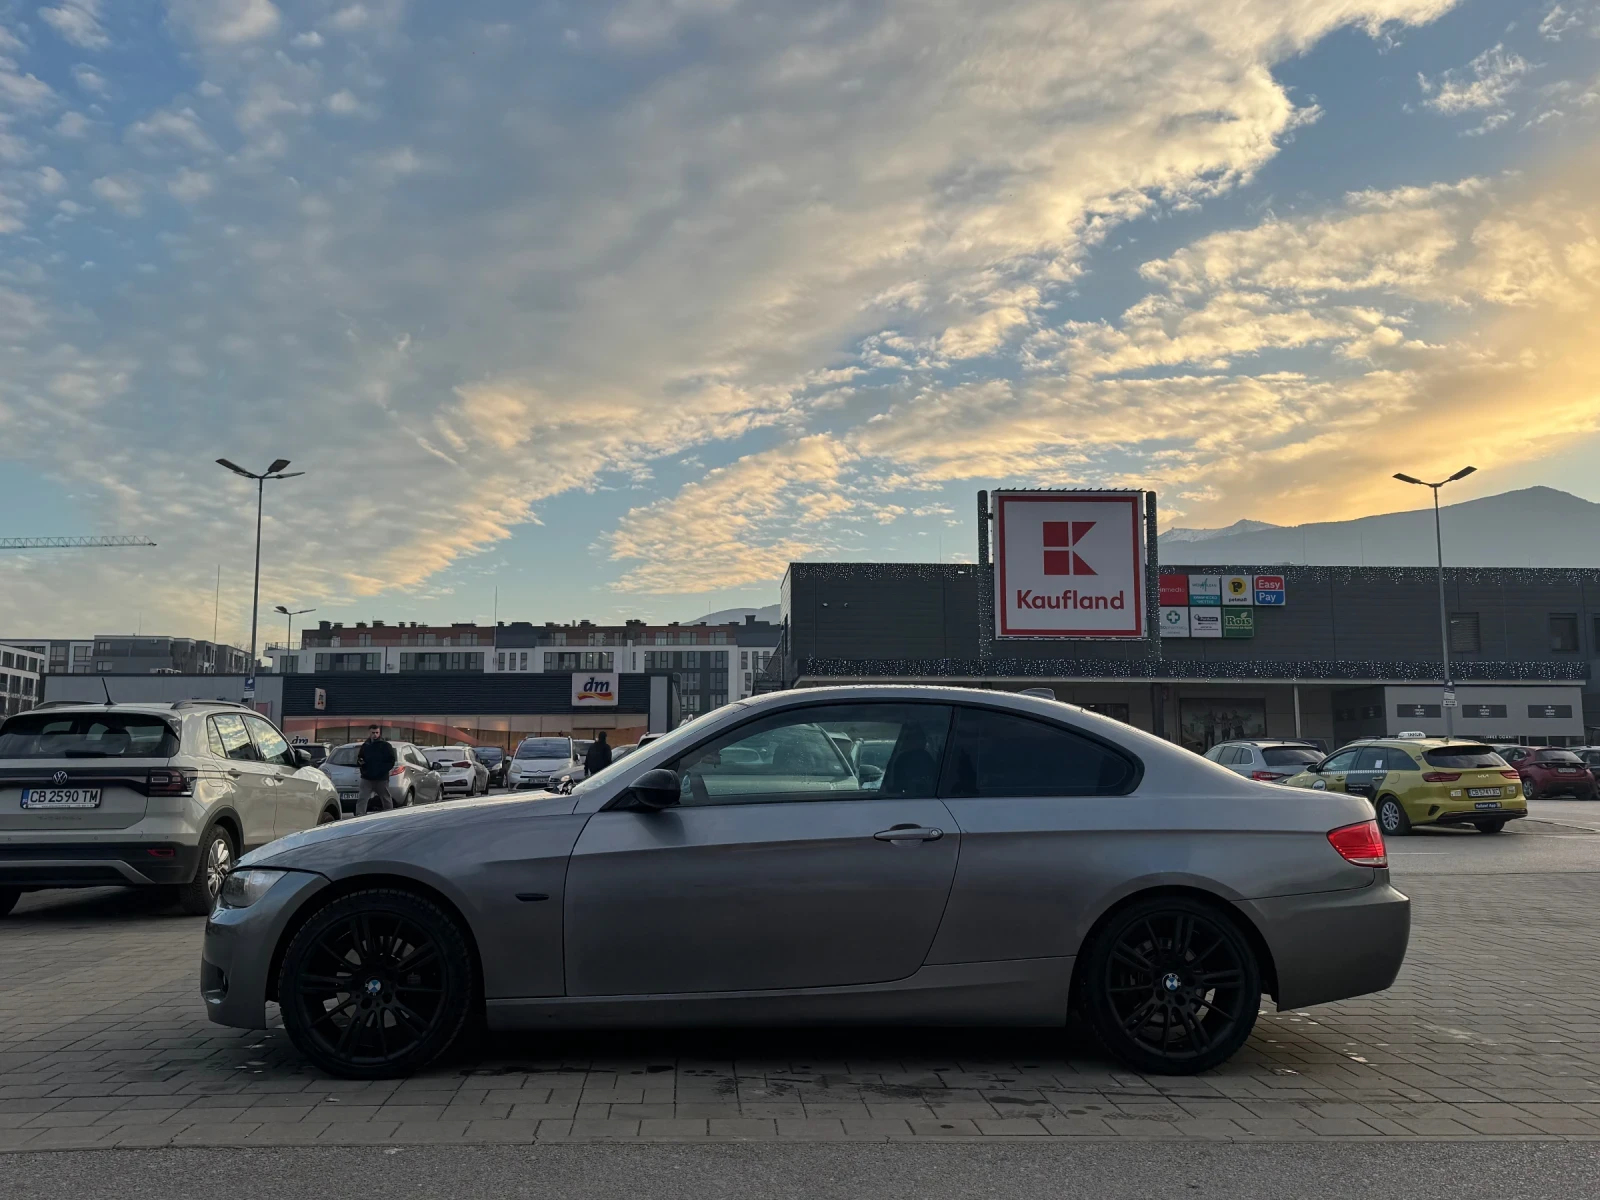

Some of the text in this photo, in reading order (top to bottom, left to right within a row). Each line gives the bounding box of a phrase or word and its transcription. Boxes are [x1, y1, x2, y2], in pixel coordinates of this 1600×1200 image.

[1258, 580, 1280, 590] Easy
[1016, 589, 1125, 610] Kaufland
[1259, 592, 1276, 603] Pay
[1225, 615, 1252, 626] Rois
[583, 676, 610, 693] dm
[30, 790, 99, 803] CB 2590 TM
